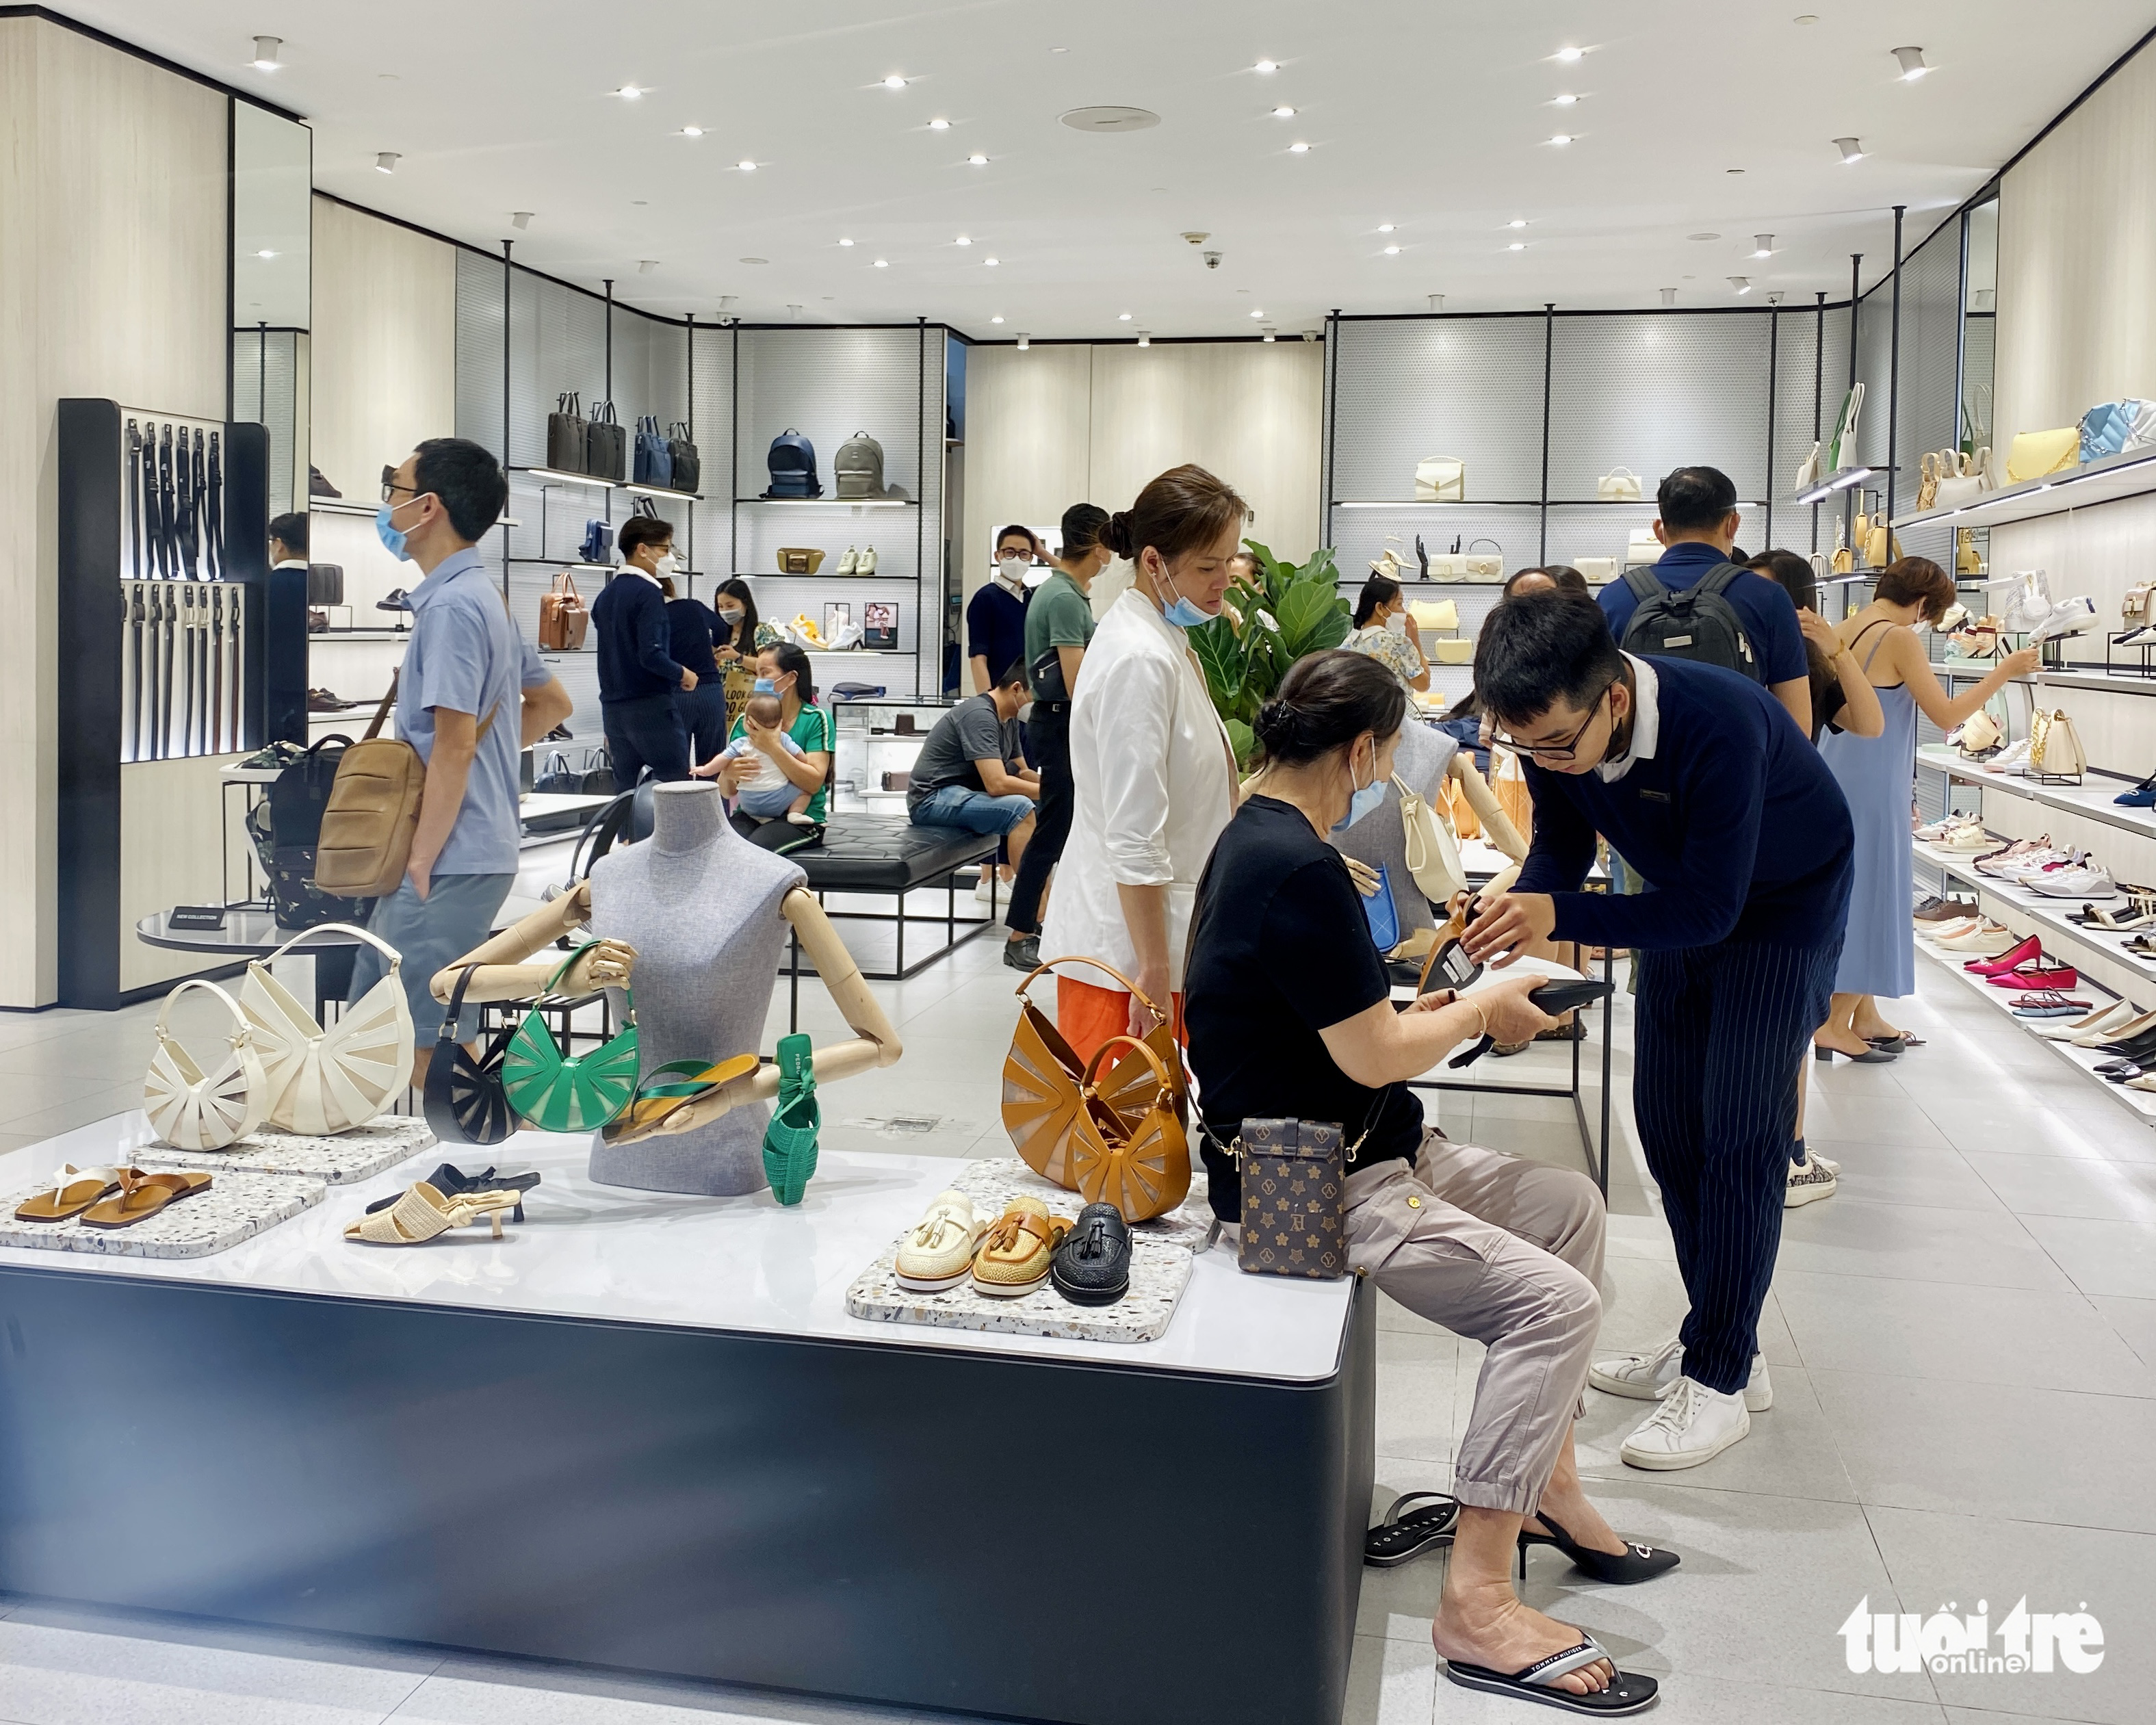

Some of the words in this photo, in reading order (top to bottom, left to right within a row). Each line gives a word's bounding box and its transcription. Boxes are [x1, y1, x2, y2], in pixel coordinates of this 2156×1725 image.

[726, 690, 746, 699] LOOK
[1531, 1657, 1554, 1672] TOMMY
[1559, 1646, 1583, 1658] HILFIGER
